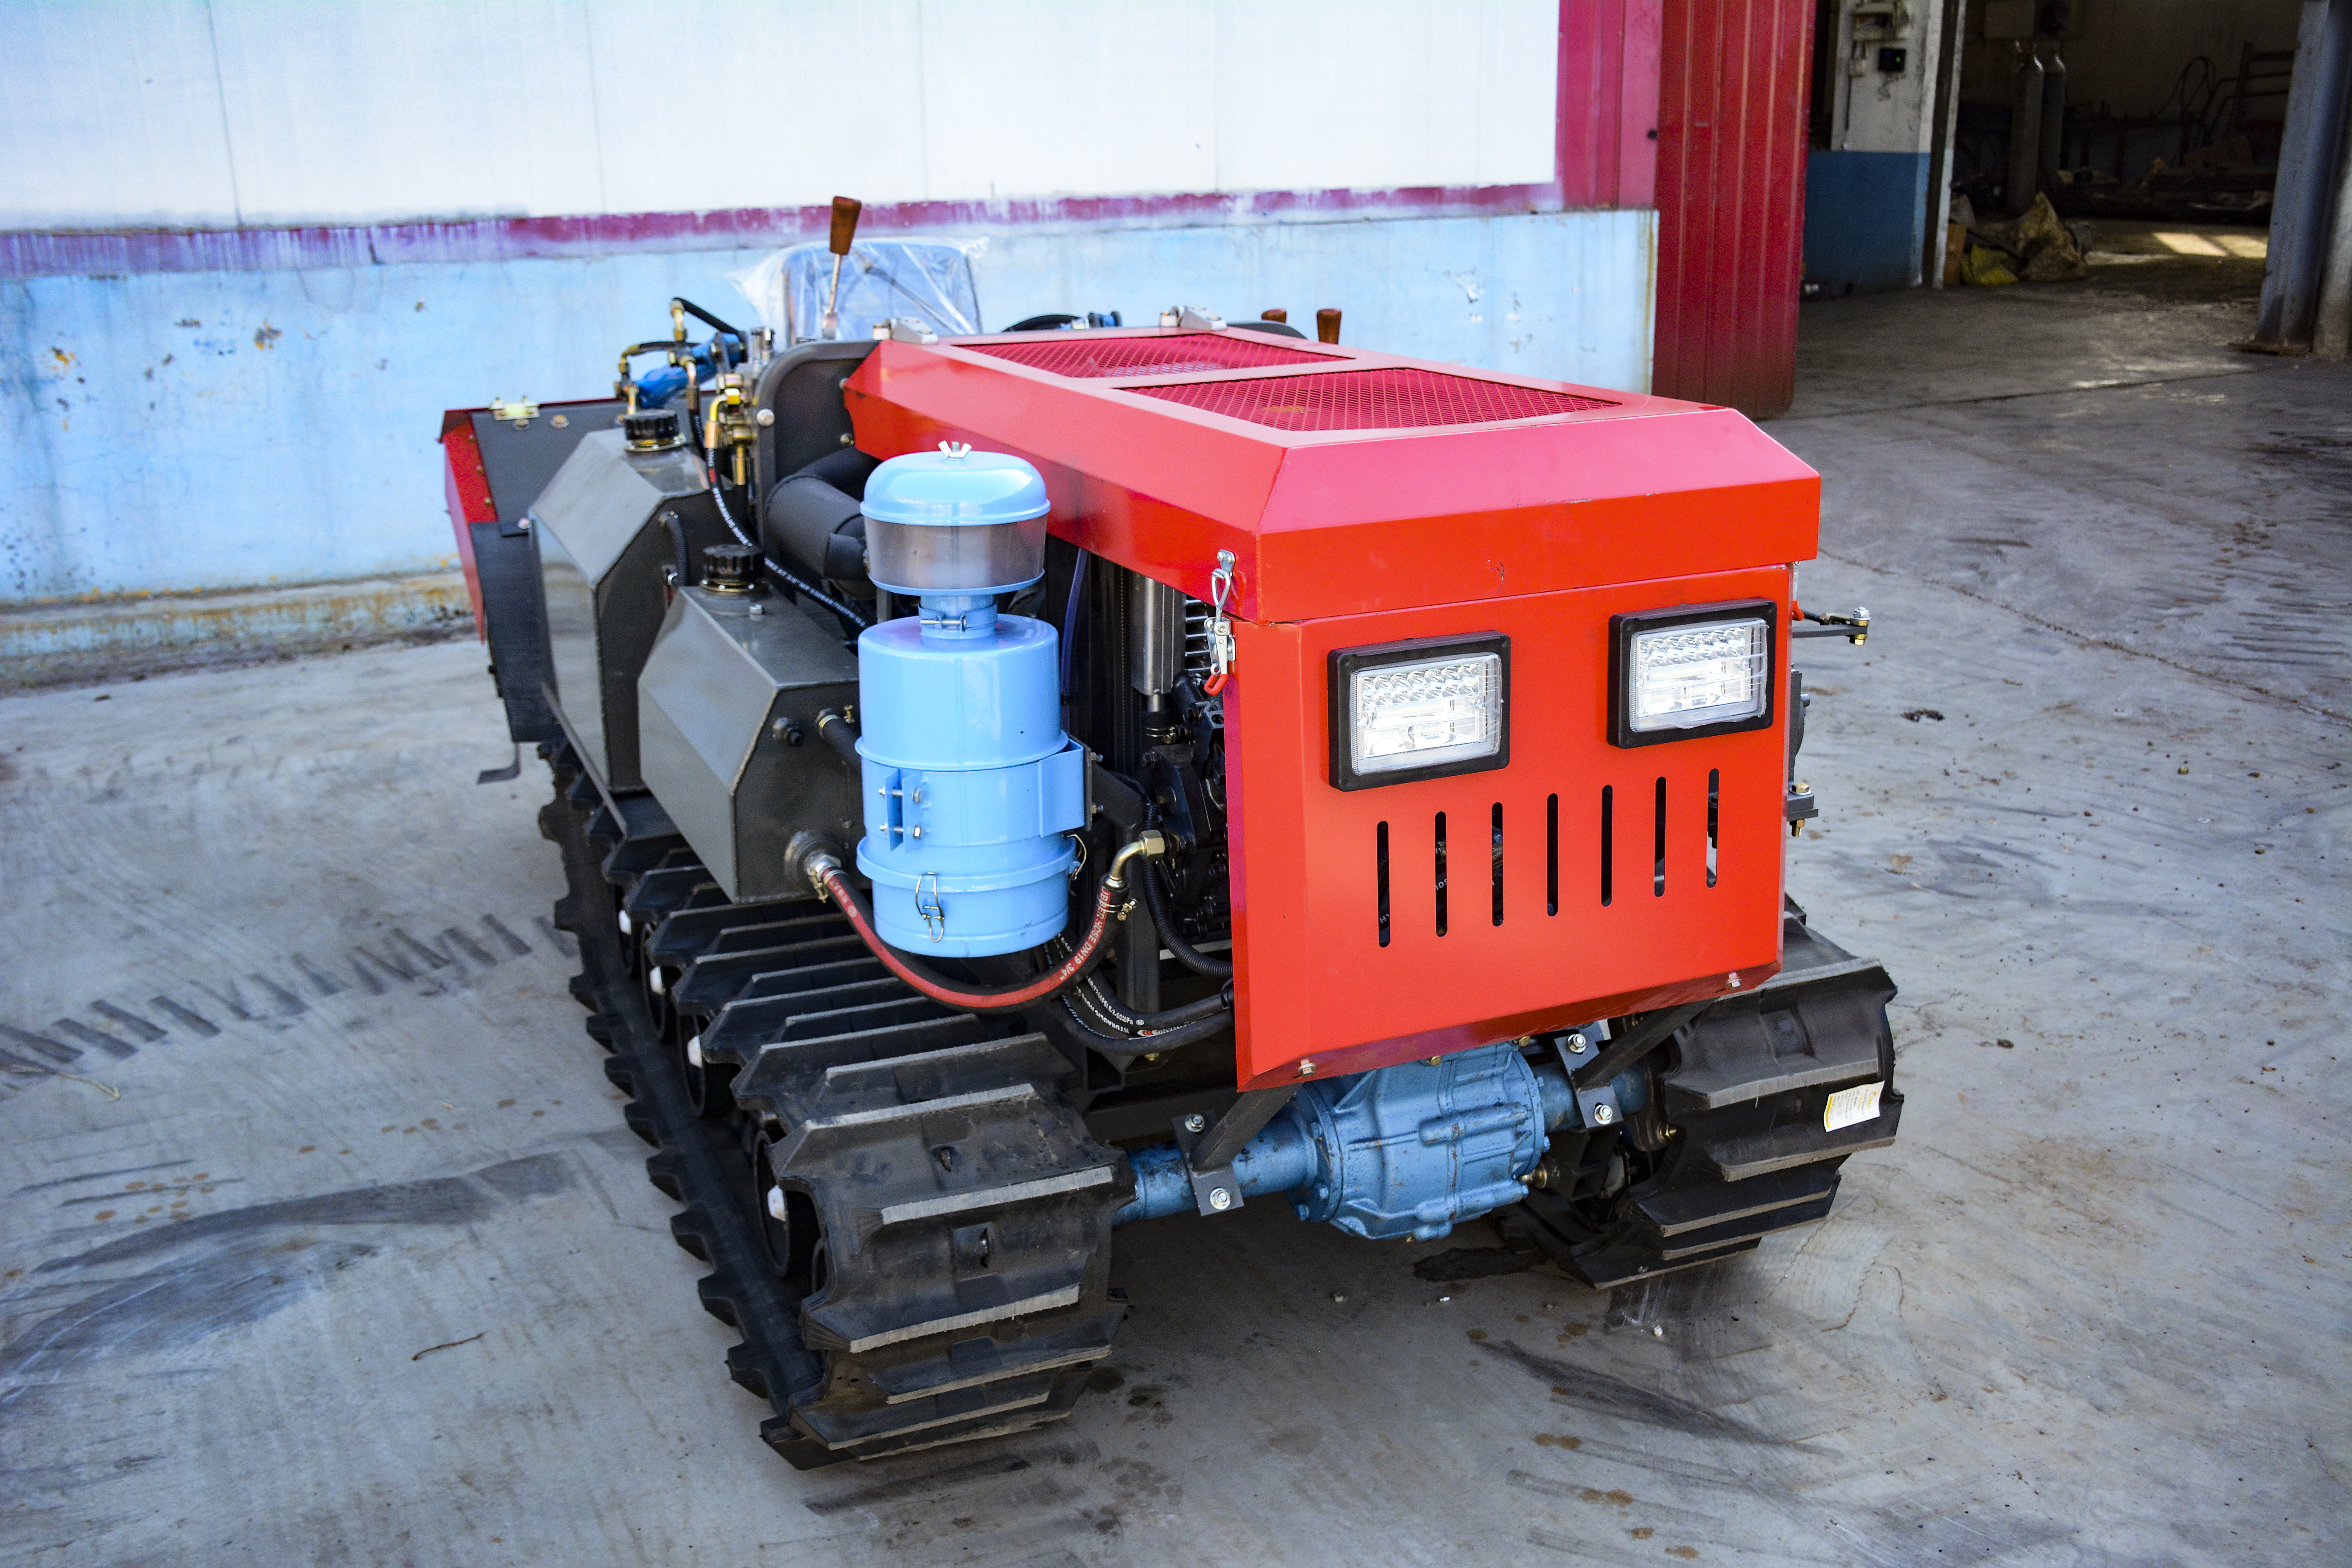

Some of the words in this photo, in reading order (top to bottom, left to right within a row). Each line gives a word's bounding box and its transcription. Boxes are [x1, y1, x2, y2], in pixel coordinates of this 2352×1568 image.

[713, 487, 735, 528] HYDRAULIC
[1088, 919, 1103, 944] HOSE
[1074, 942, 1093, 964] DN19
[1060, 963, 1075, 980] 3/4"
